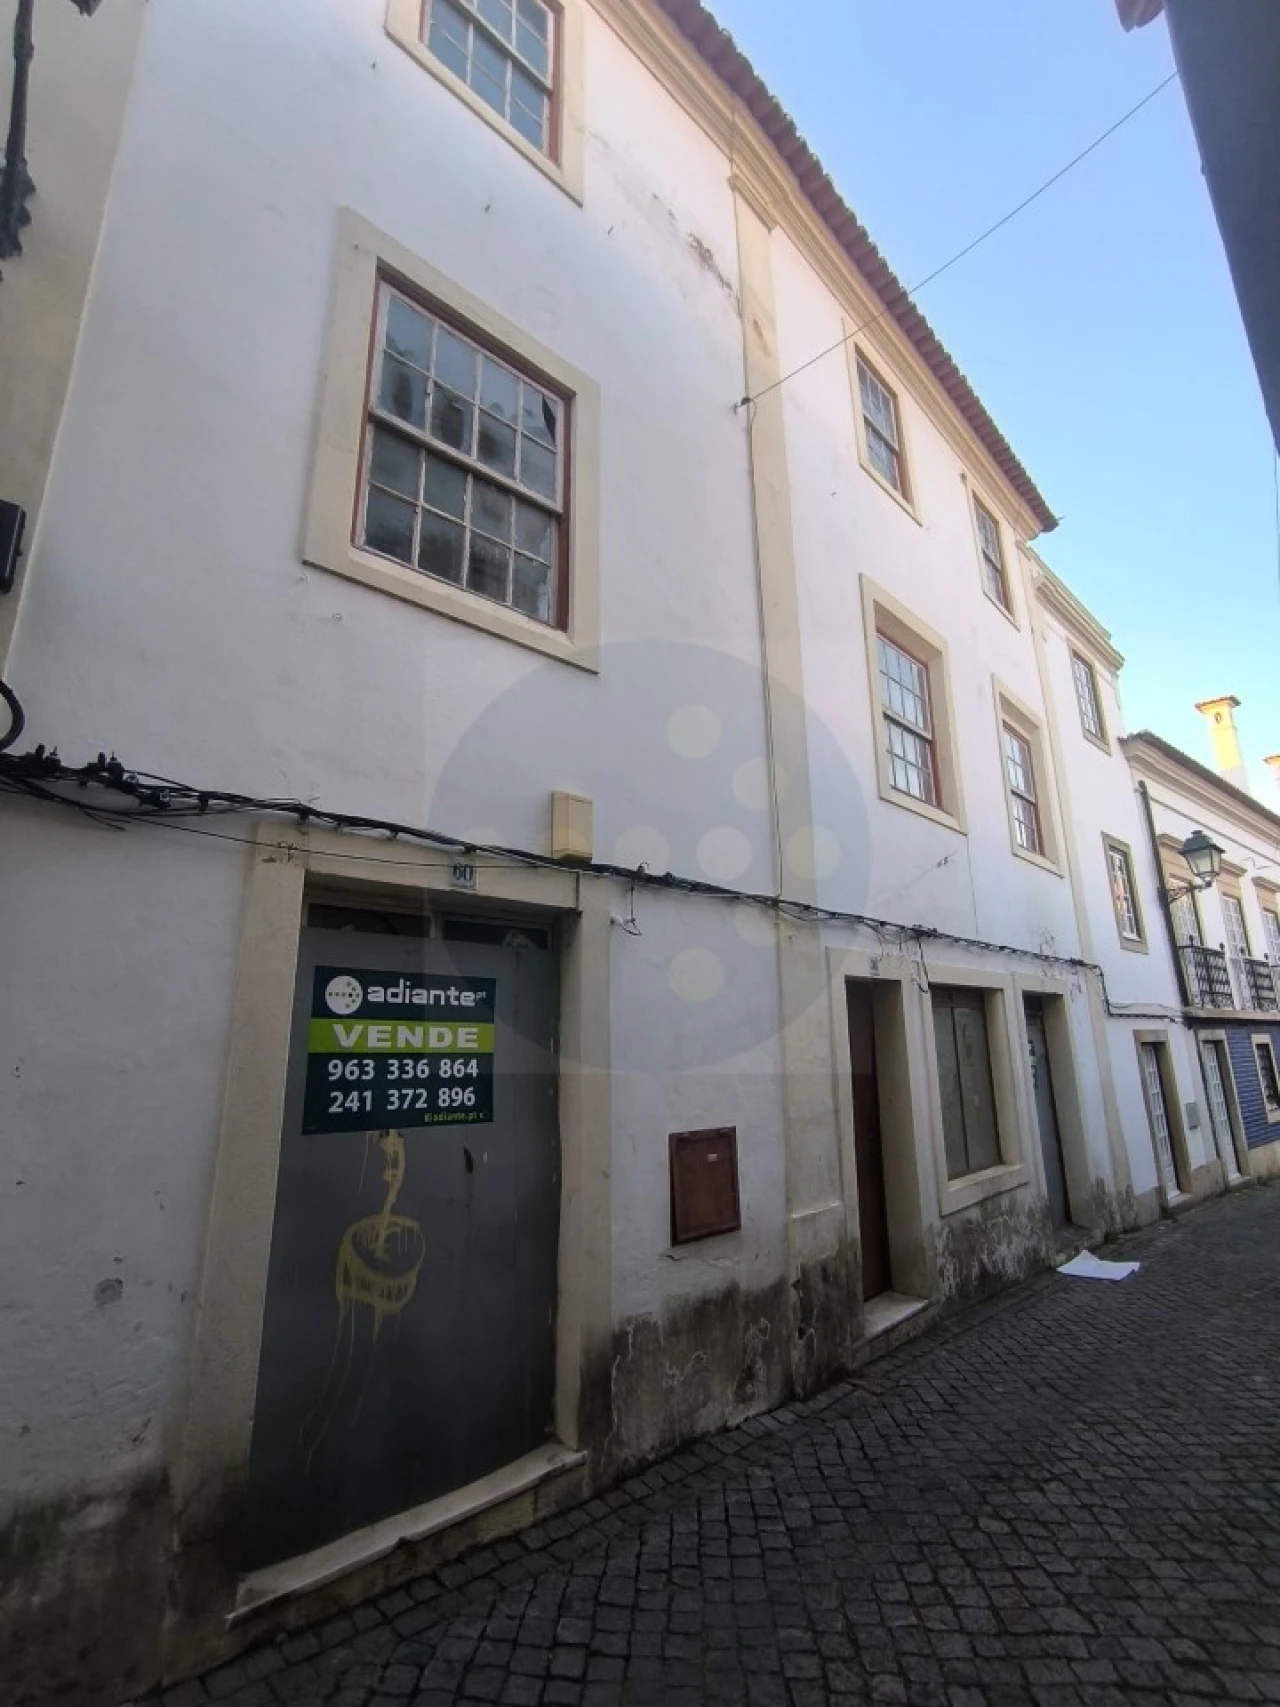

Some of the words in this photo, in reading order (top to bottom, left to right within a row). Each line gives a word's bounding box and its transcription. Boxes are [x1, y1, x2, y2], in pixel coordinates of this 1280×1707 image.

[367, 977, 475, 1007] adiante
[332, 1023, 479, 1049] VENDE
[328, 1059, 375, 1081] 963
[386, 1059, 430, 1080] 336
[438, 1058, 479, 1079] 864
[328, 1090, 374, 1114] 241
[386, 1087, 428, 1111] 372
[438, 1085, 476, 1108] 896
